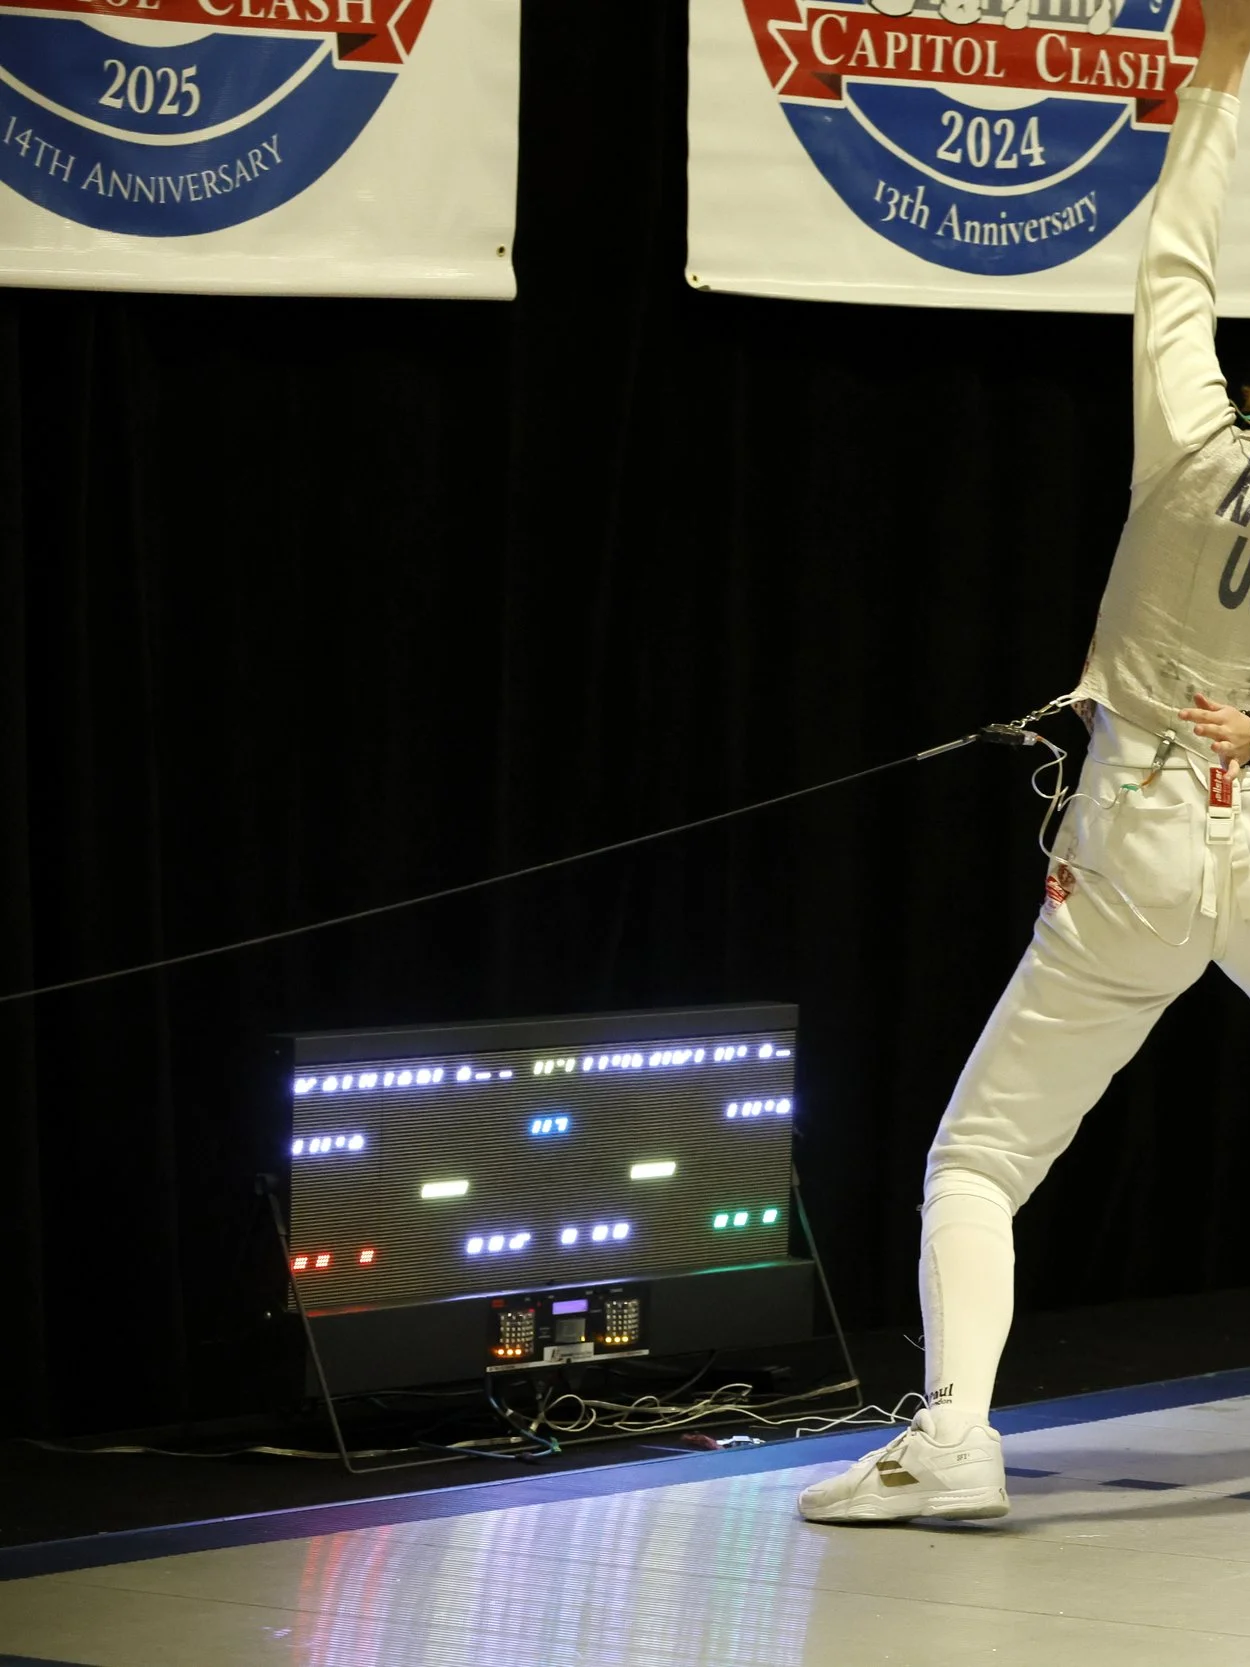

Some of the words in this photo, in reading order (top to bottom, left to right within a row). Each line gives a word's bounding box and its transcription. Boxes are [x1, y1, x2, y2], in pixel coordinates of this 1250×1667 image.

[810, 13, 1005, 79] CAPITOL
[1035, 32, 1168, 91] CLASH
[98, 59, 201, 117] 2025
[2, 115, 77, 183] 14TH
[80, 133, 284, 204] ANNIVERSARY
[935, 109, 1047, 169] 2024
[873, 179, 931, 230] 13th
[935, 190, 1098, 246] Anniversary
